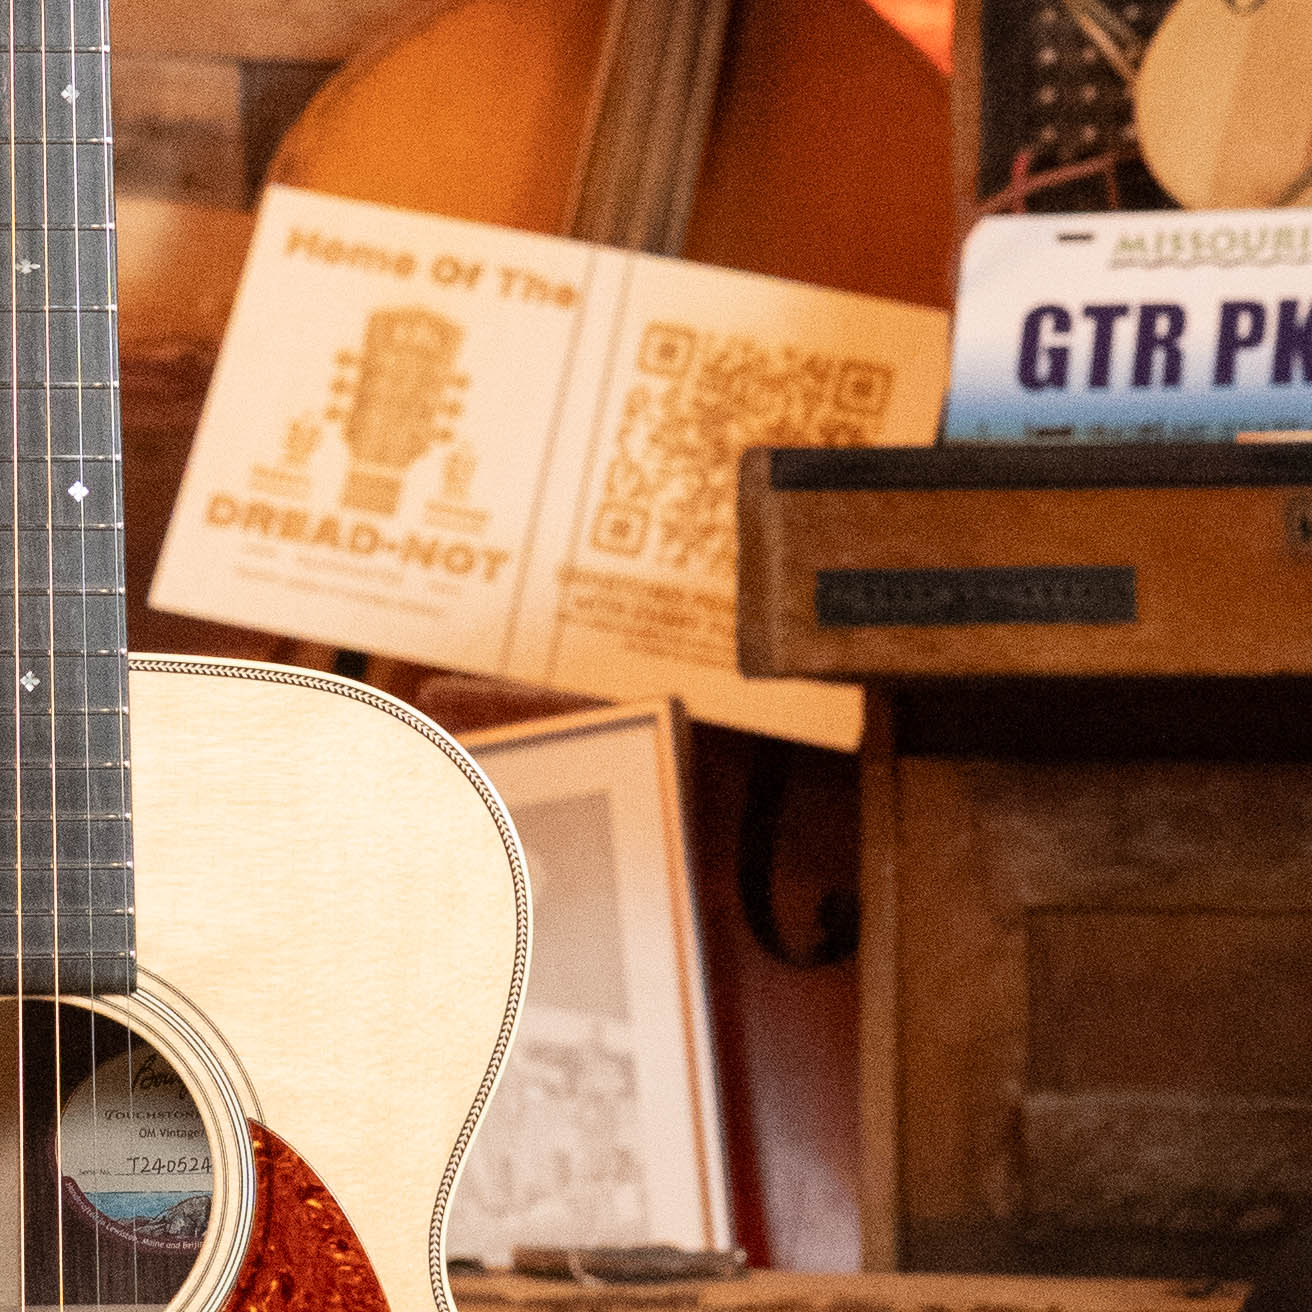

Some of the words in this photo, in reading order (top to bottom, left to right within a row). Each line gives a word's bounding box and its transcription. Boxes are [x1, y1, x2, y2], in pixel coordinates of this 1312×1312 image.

[285, 227, 417, 280] Home
[430, 254, 482, 290] Of
[496, 265, 582, 310] The
[1112, 224, 1312, 268] MISSOURI
[1017, 303, 1186, 392] GTR
[204, 491, 510, 583] DREAD-NOT
[138, 1128, 156, 1138] OM
[166, 1241, 181, 1250] and
